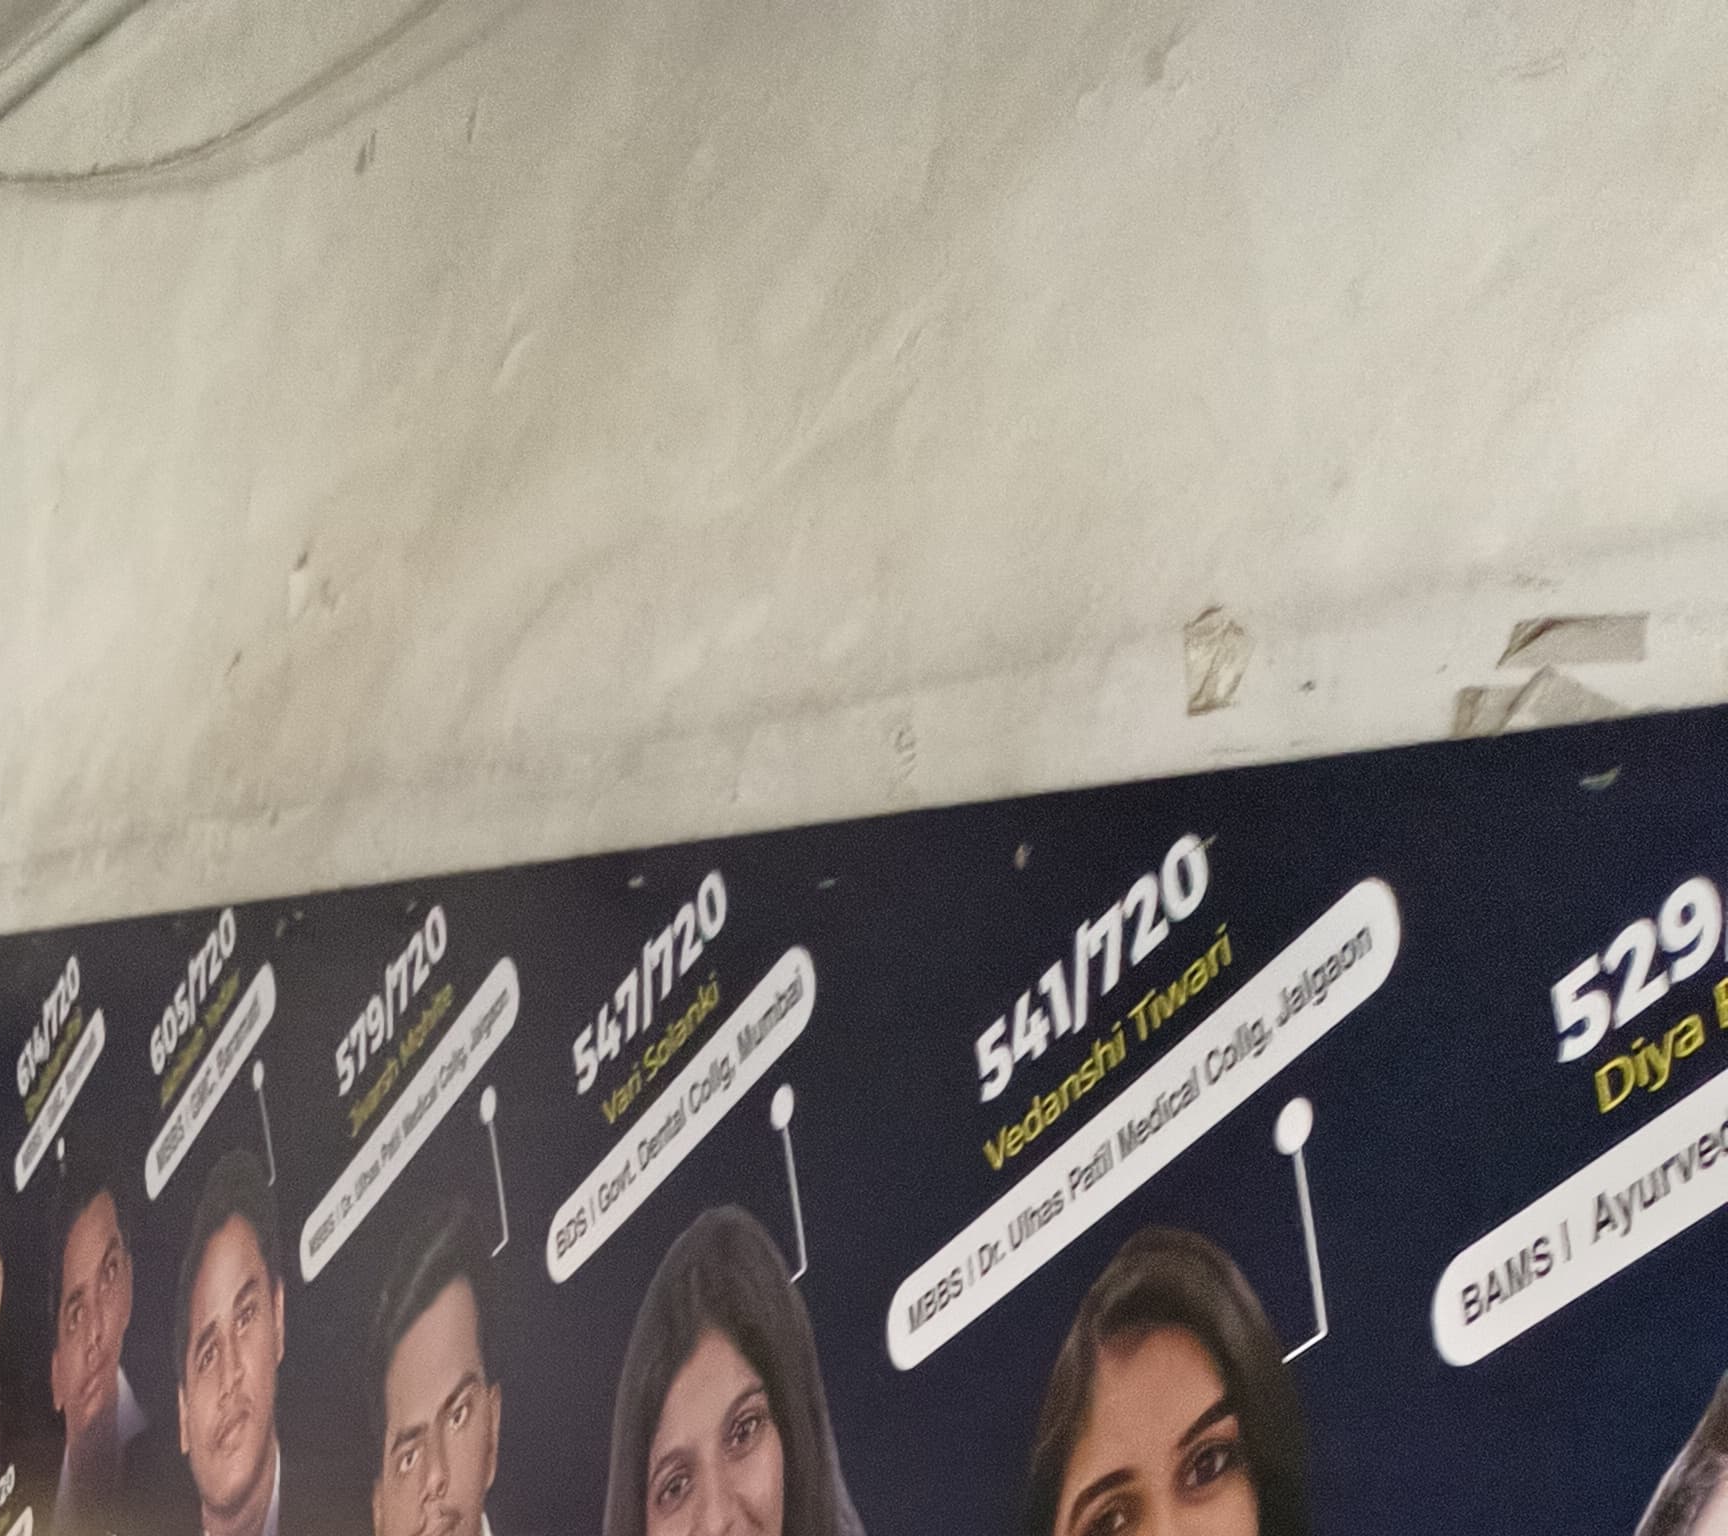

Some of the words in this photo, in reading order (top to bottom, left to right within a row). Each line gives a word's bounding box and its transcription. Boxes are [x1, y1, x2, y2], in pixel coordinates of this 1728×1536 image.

[149, 907, 236, 1076] 605/720
[334, 904, 447, 1097] 579/720
[572, 868, 727, 1095] 547/720
[642, 969, 720, 1082] Solanki
[974, 833, 1210, 1103] 541/720
[982, 1020, 1127, 1171] Vedanshi
[1128, 921, 1232, 1042] Tiwari
[1550, 875, 1728, 1064] 529
[1594, 1013, 1706, 1115] Diya
[636, 1096, 688, 1172] Dental
[736, 963, 804, 1065] Mumbai
[907, 1267, 964, 1335] MBBS
[1067, 1138, 1115, 1201] Patil
[1116, 1065, 1201, 1157] Medical
[1275, 925, 1374, 1028] Jalgaon
[1459, 1235, 1555, 1327] BAMS
